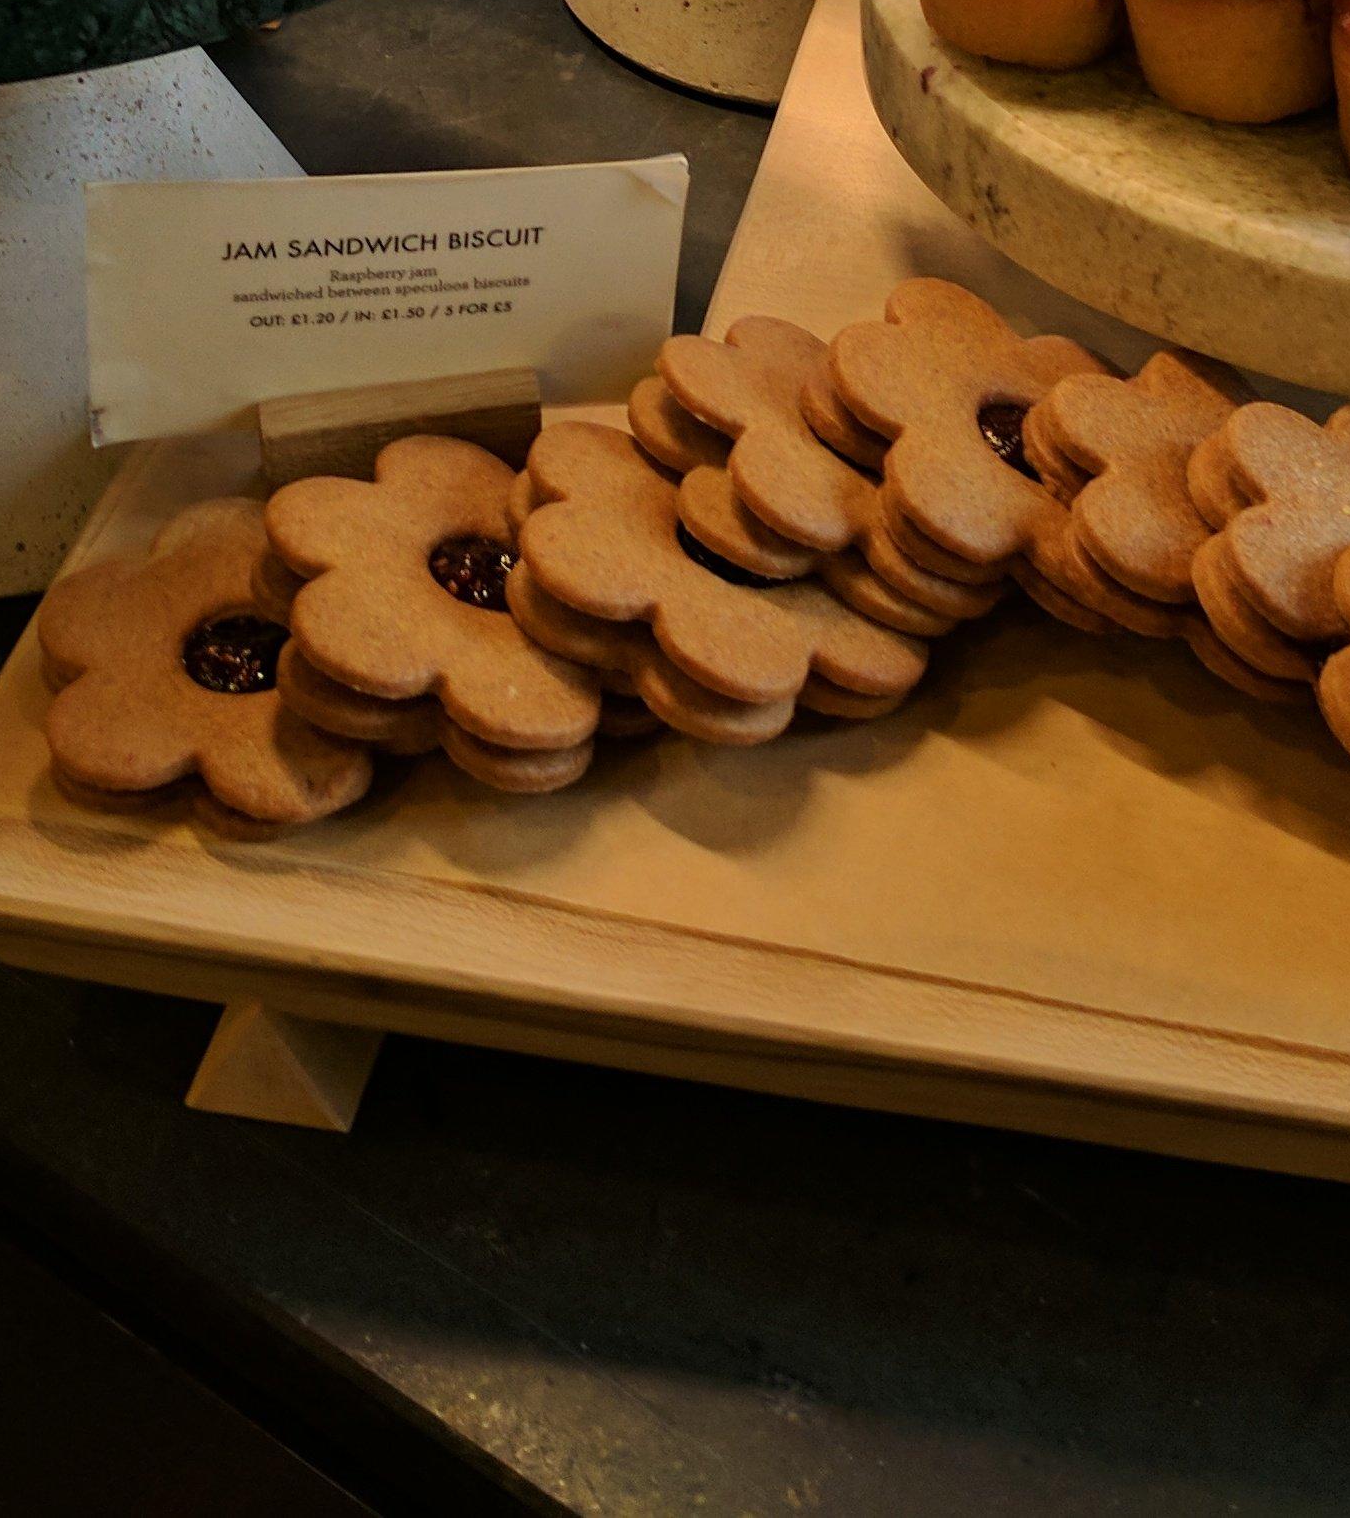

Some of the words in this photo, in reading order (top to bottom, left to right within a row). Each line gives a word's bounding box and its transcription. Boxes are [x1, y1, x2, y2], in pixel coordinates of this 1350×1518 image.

[222, 241, 276, 261] JAM
[288, 232, 438, 259] SANDWICH
[448, 227, 544, 250] BISCUIT
[331, 267, 406, 283] Raspberry
[408, 268, 438, 281] jam
[233, 286, 322, 303] sandwiched
[328, 286, 391, 299] between
[395, 279, 469, 297] speculoos
[474, 276, 530, 290] biscuits
[250, 313, 285, 328] OUT:
[291, 312, 335, 326] £1.20
[355, 310, 376, 324] IN:
[381, 306, 425, 320] £1.50
[430, 305, 439, 319] /
[459, 302, 489, 316] FOR
[494, 300, 513, 313] £5
